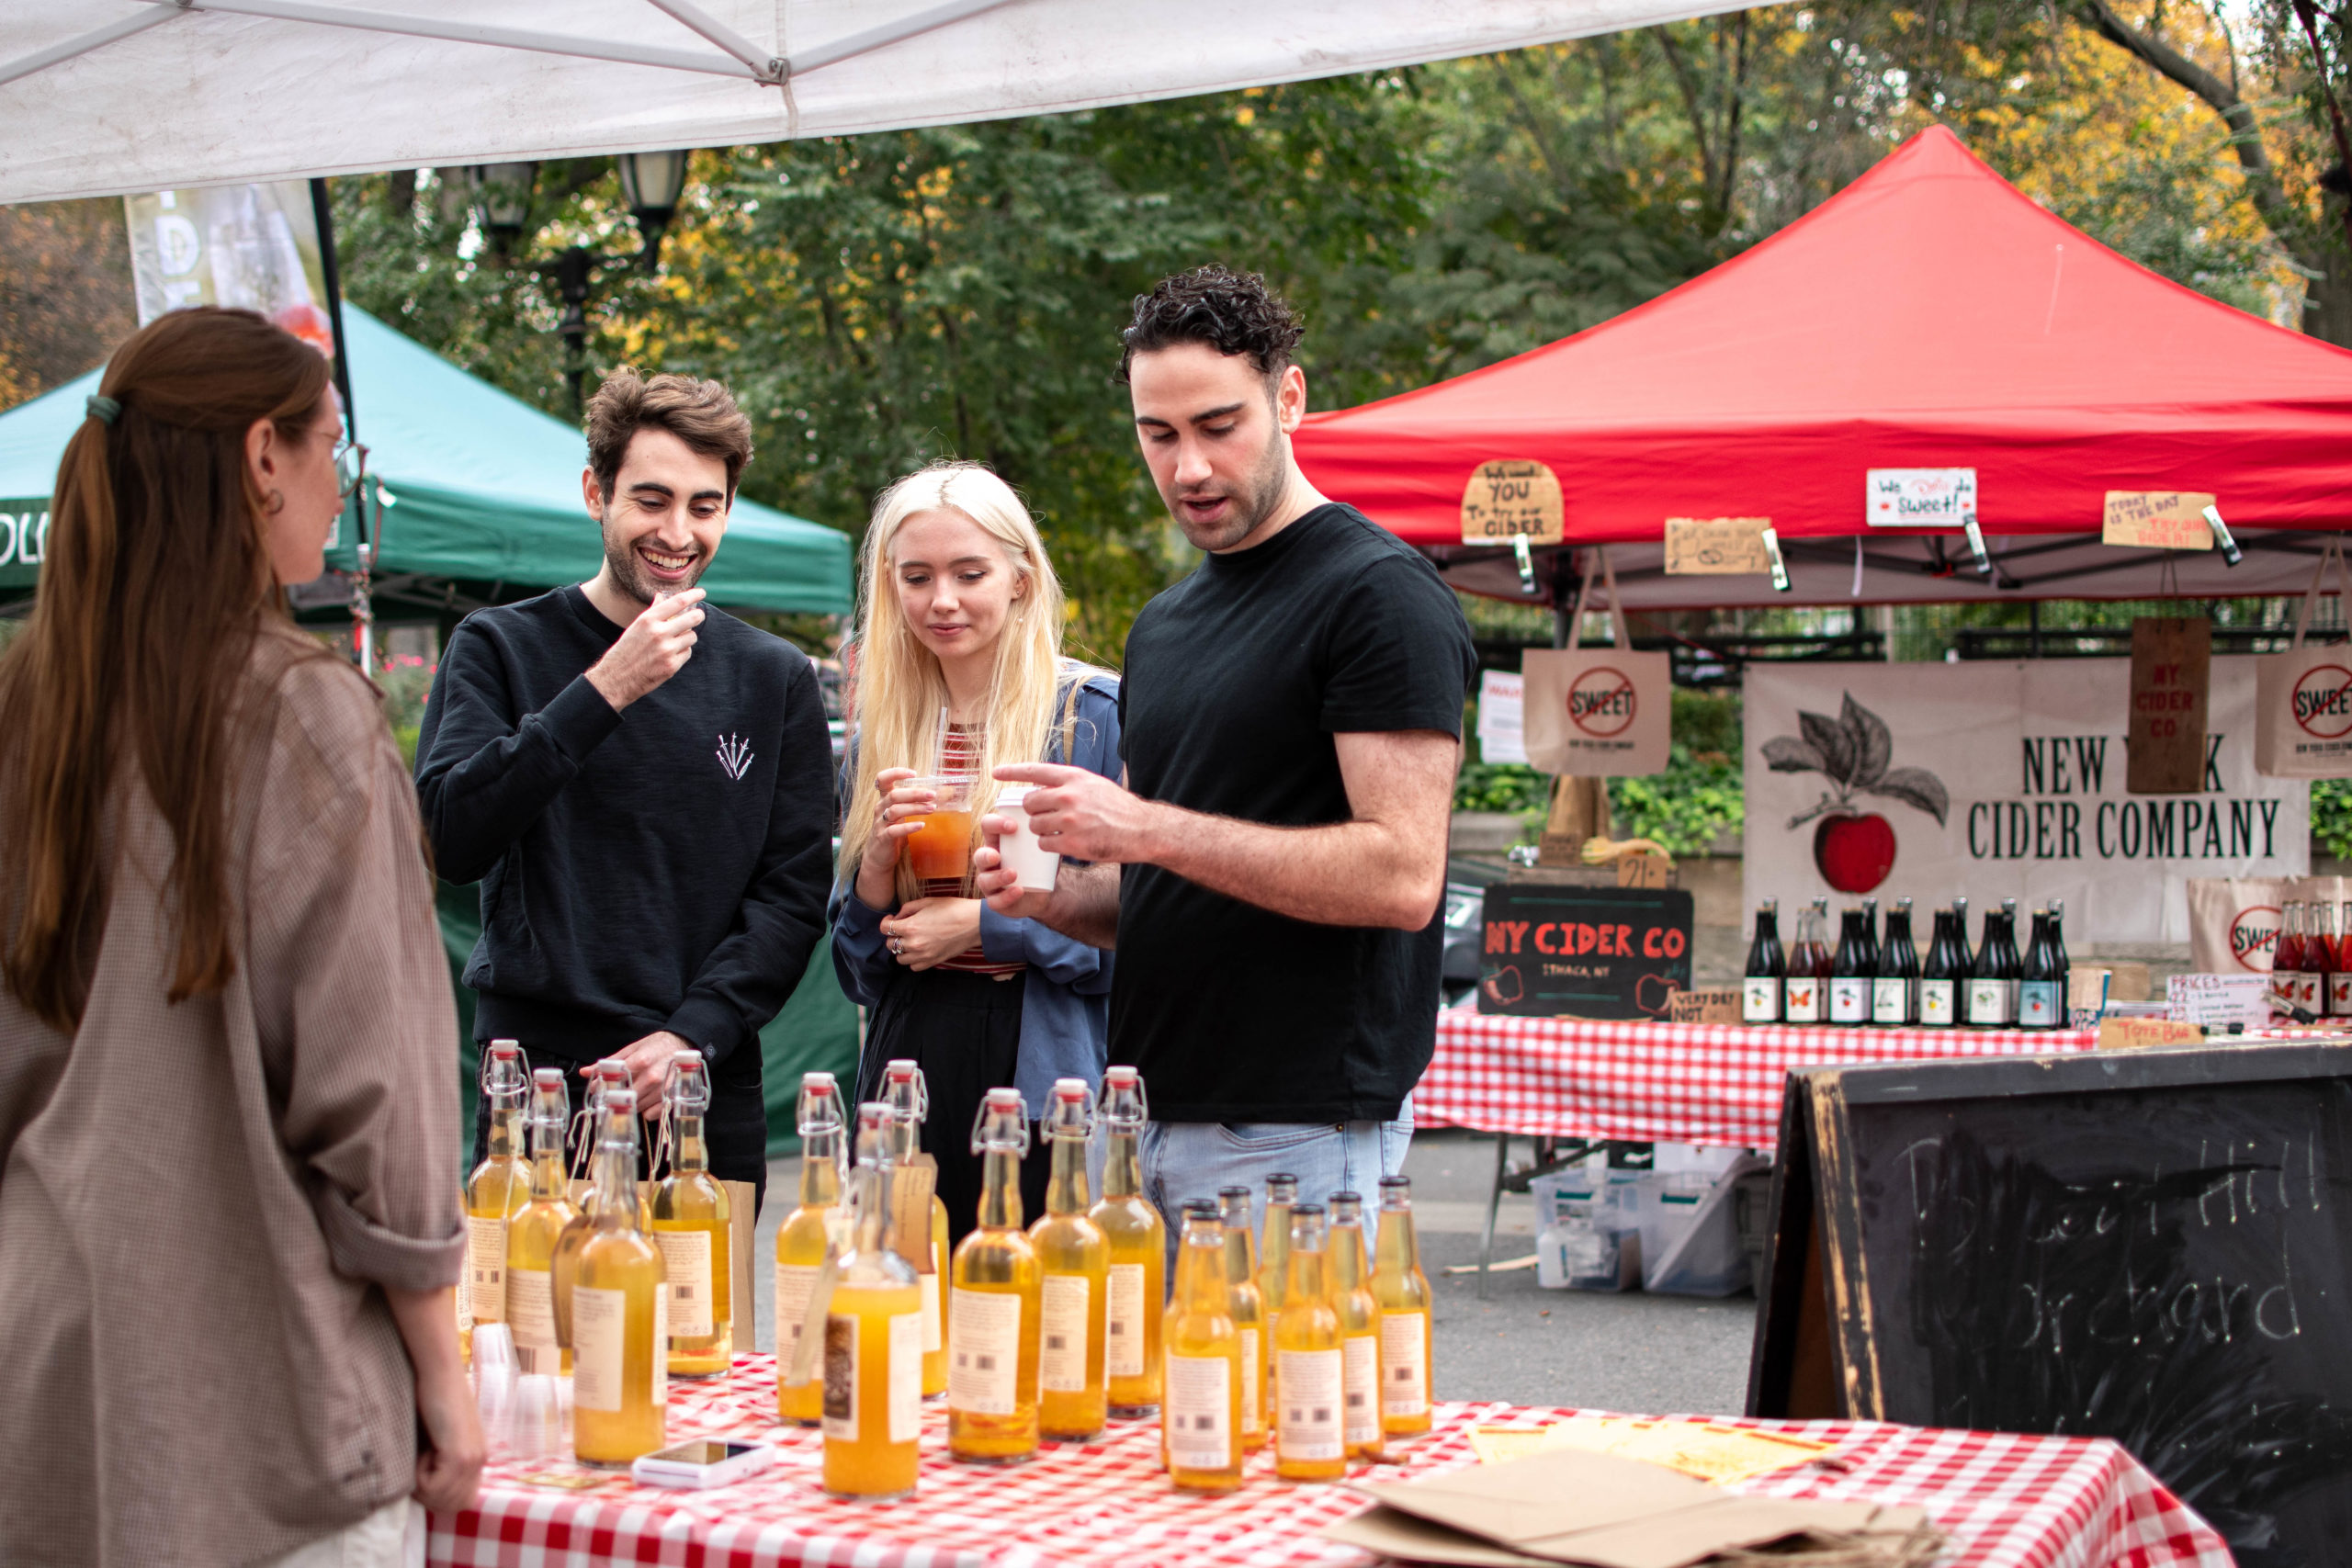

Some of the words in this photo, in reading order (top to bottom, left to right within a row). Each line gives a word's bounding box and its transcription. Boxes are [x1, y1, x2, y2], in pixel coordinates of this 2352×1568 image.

[1488, 481, 1530, 502] YOU
[2125, 505, 2153, 520] THE
[1485, 517, 1545, 536] CIDER
[1572, 690, 1633, 716] SWEET
[2136, 690, 2194, 712] CIDER
[2297, 687, 2352, 716] SWEE
[2151, 717, 2177, 738] CO
[2022, 736, 2108, 795] NEW
[1968, 801, 2081, 860] CIDER
[2097, 798, 2281, 860] COMPANY
[1485, 920, 1531, 954] NY
[1533, 922, 1635, 958] CIDER
[1643, 927, 1686, 959] CO
[2234, 926, 2280, 953] SWE
[1676, 993, 1708, 1006] VERY
[1674, 1006, 1703, 1022] NOT
